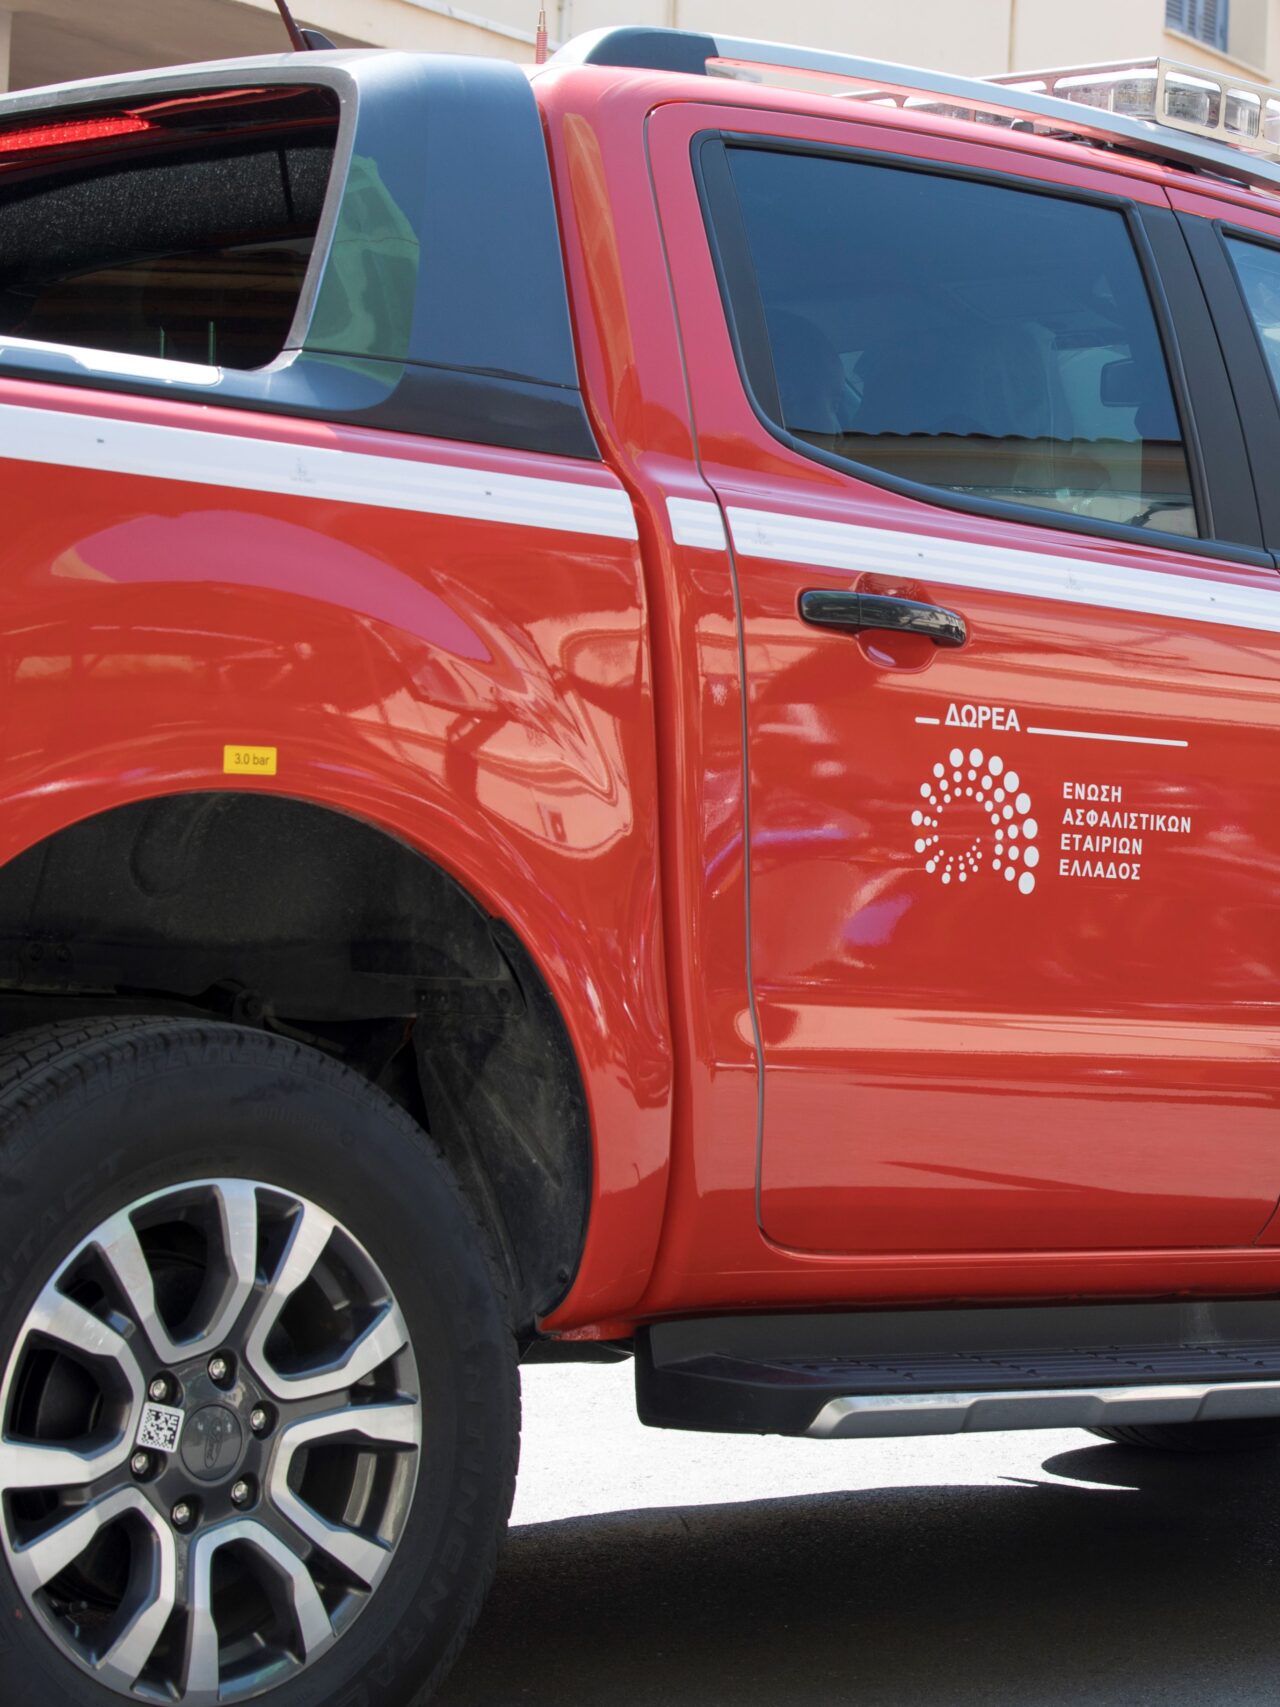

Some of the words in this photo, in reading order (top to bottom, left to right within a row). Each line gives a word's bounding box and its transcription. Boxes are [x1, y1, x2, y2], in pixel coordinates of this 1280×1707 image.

[944, 703, 1021, 732] ΔΩΡΕΑ
[234, 752, 250, 765] 3.0
[252, 752, 270, 766] bar
[1062, 782, 1122, 803] ΕΝΩΣΗ
[1062, 808, 1192, 834] ΑΣΦΑΛΙΣΤΙΚΩΝ
[1060, 833, 1143, 856] ΕΤΑΙΡΙΩΝ
[1059, 858, 1142, 881] ΕΛΛΑΔΟΣ
